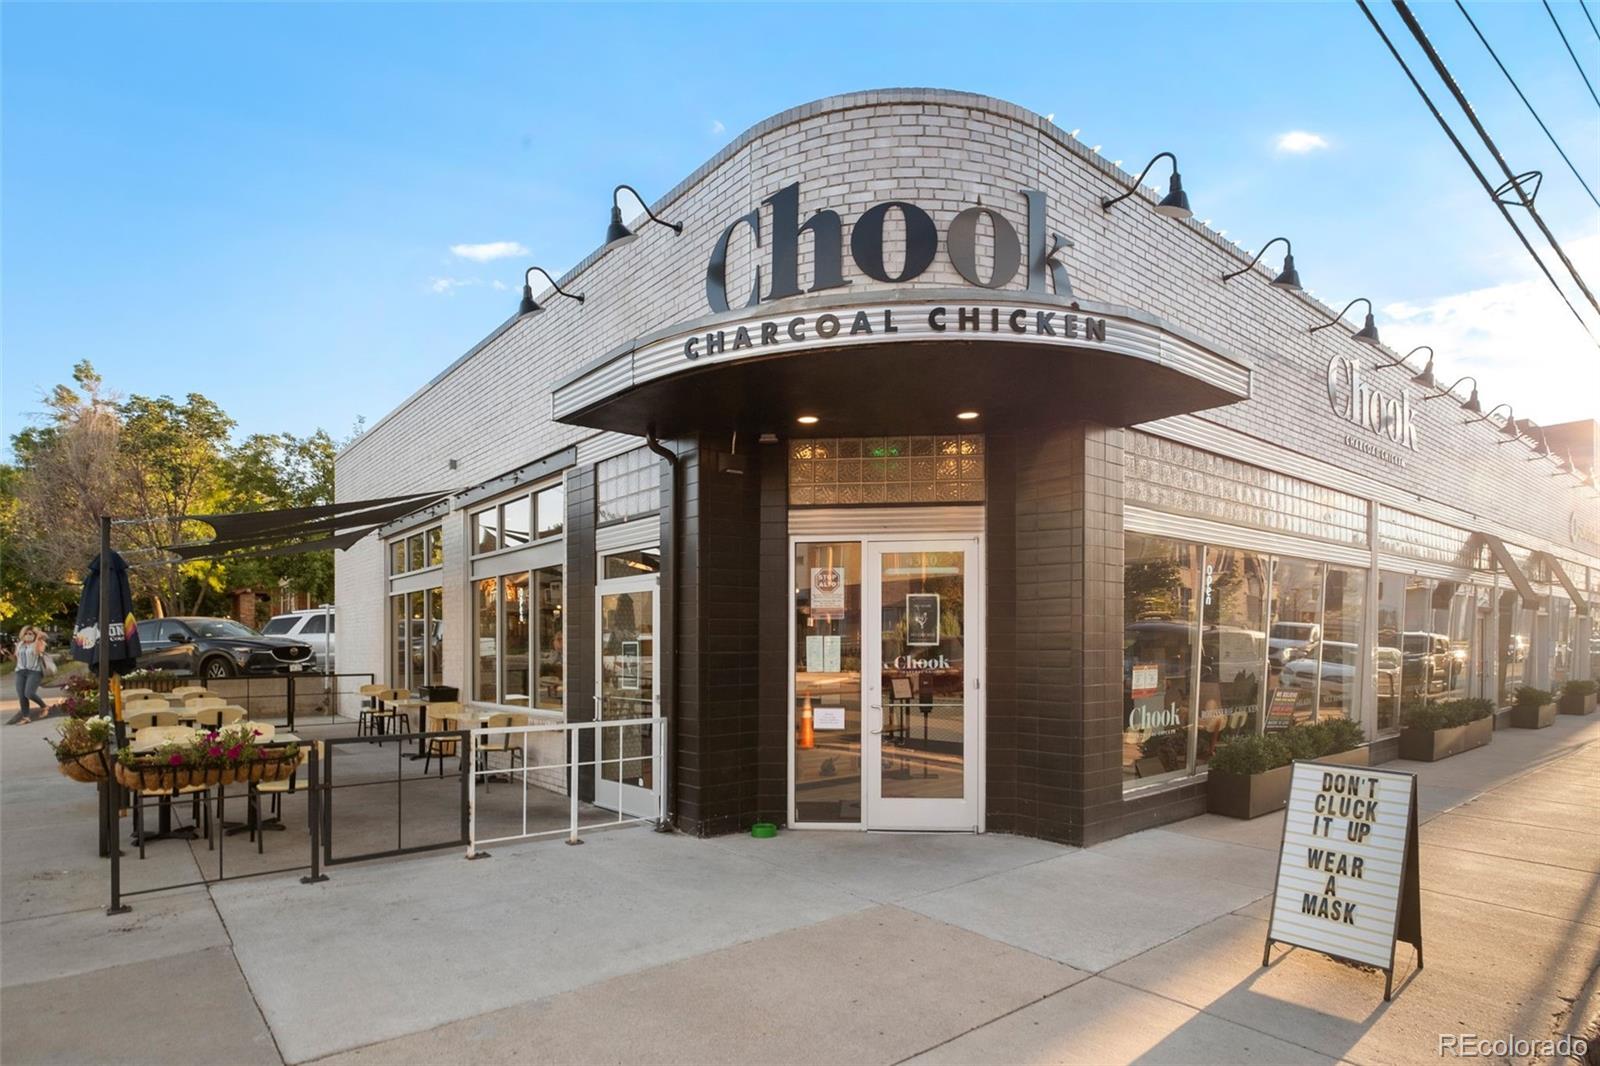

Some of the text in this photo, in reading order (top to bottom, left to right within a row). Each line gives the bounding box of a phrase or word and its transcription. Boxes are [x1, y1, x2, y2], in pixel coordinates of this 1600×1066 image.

[706, 181, 1076, 313] Chook
[684, 306, 1107, 361] CHARCOAL CHICKEN
[1327, 354, 1419, 453] Chook
[894, 654, 950, 670] Chook
[1129, 701, 1181, 731] Chook
[1322, 772, 1379, 799] DON'T
[1314, 794, 1379, 823] CLUCK
[1312, 815, 1371, 843] IT UP
[1307, 848, 1364, 879] WEAR
[1324, 875, 1336, 897] A
[1301, 893, 1357, 926] MASK
